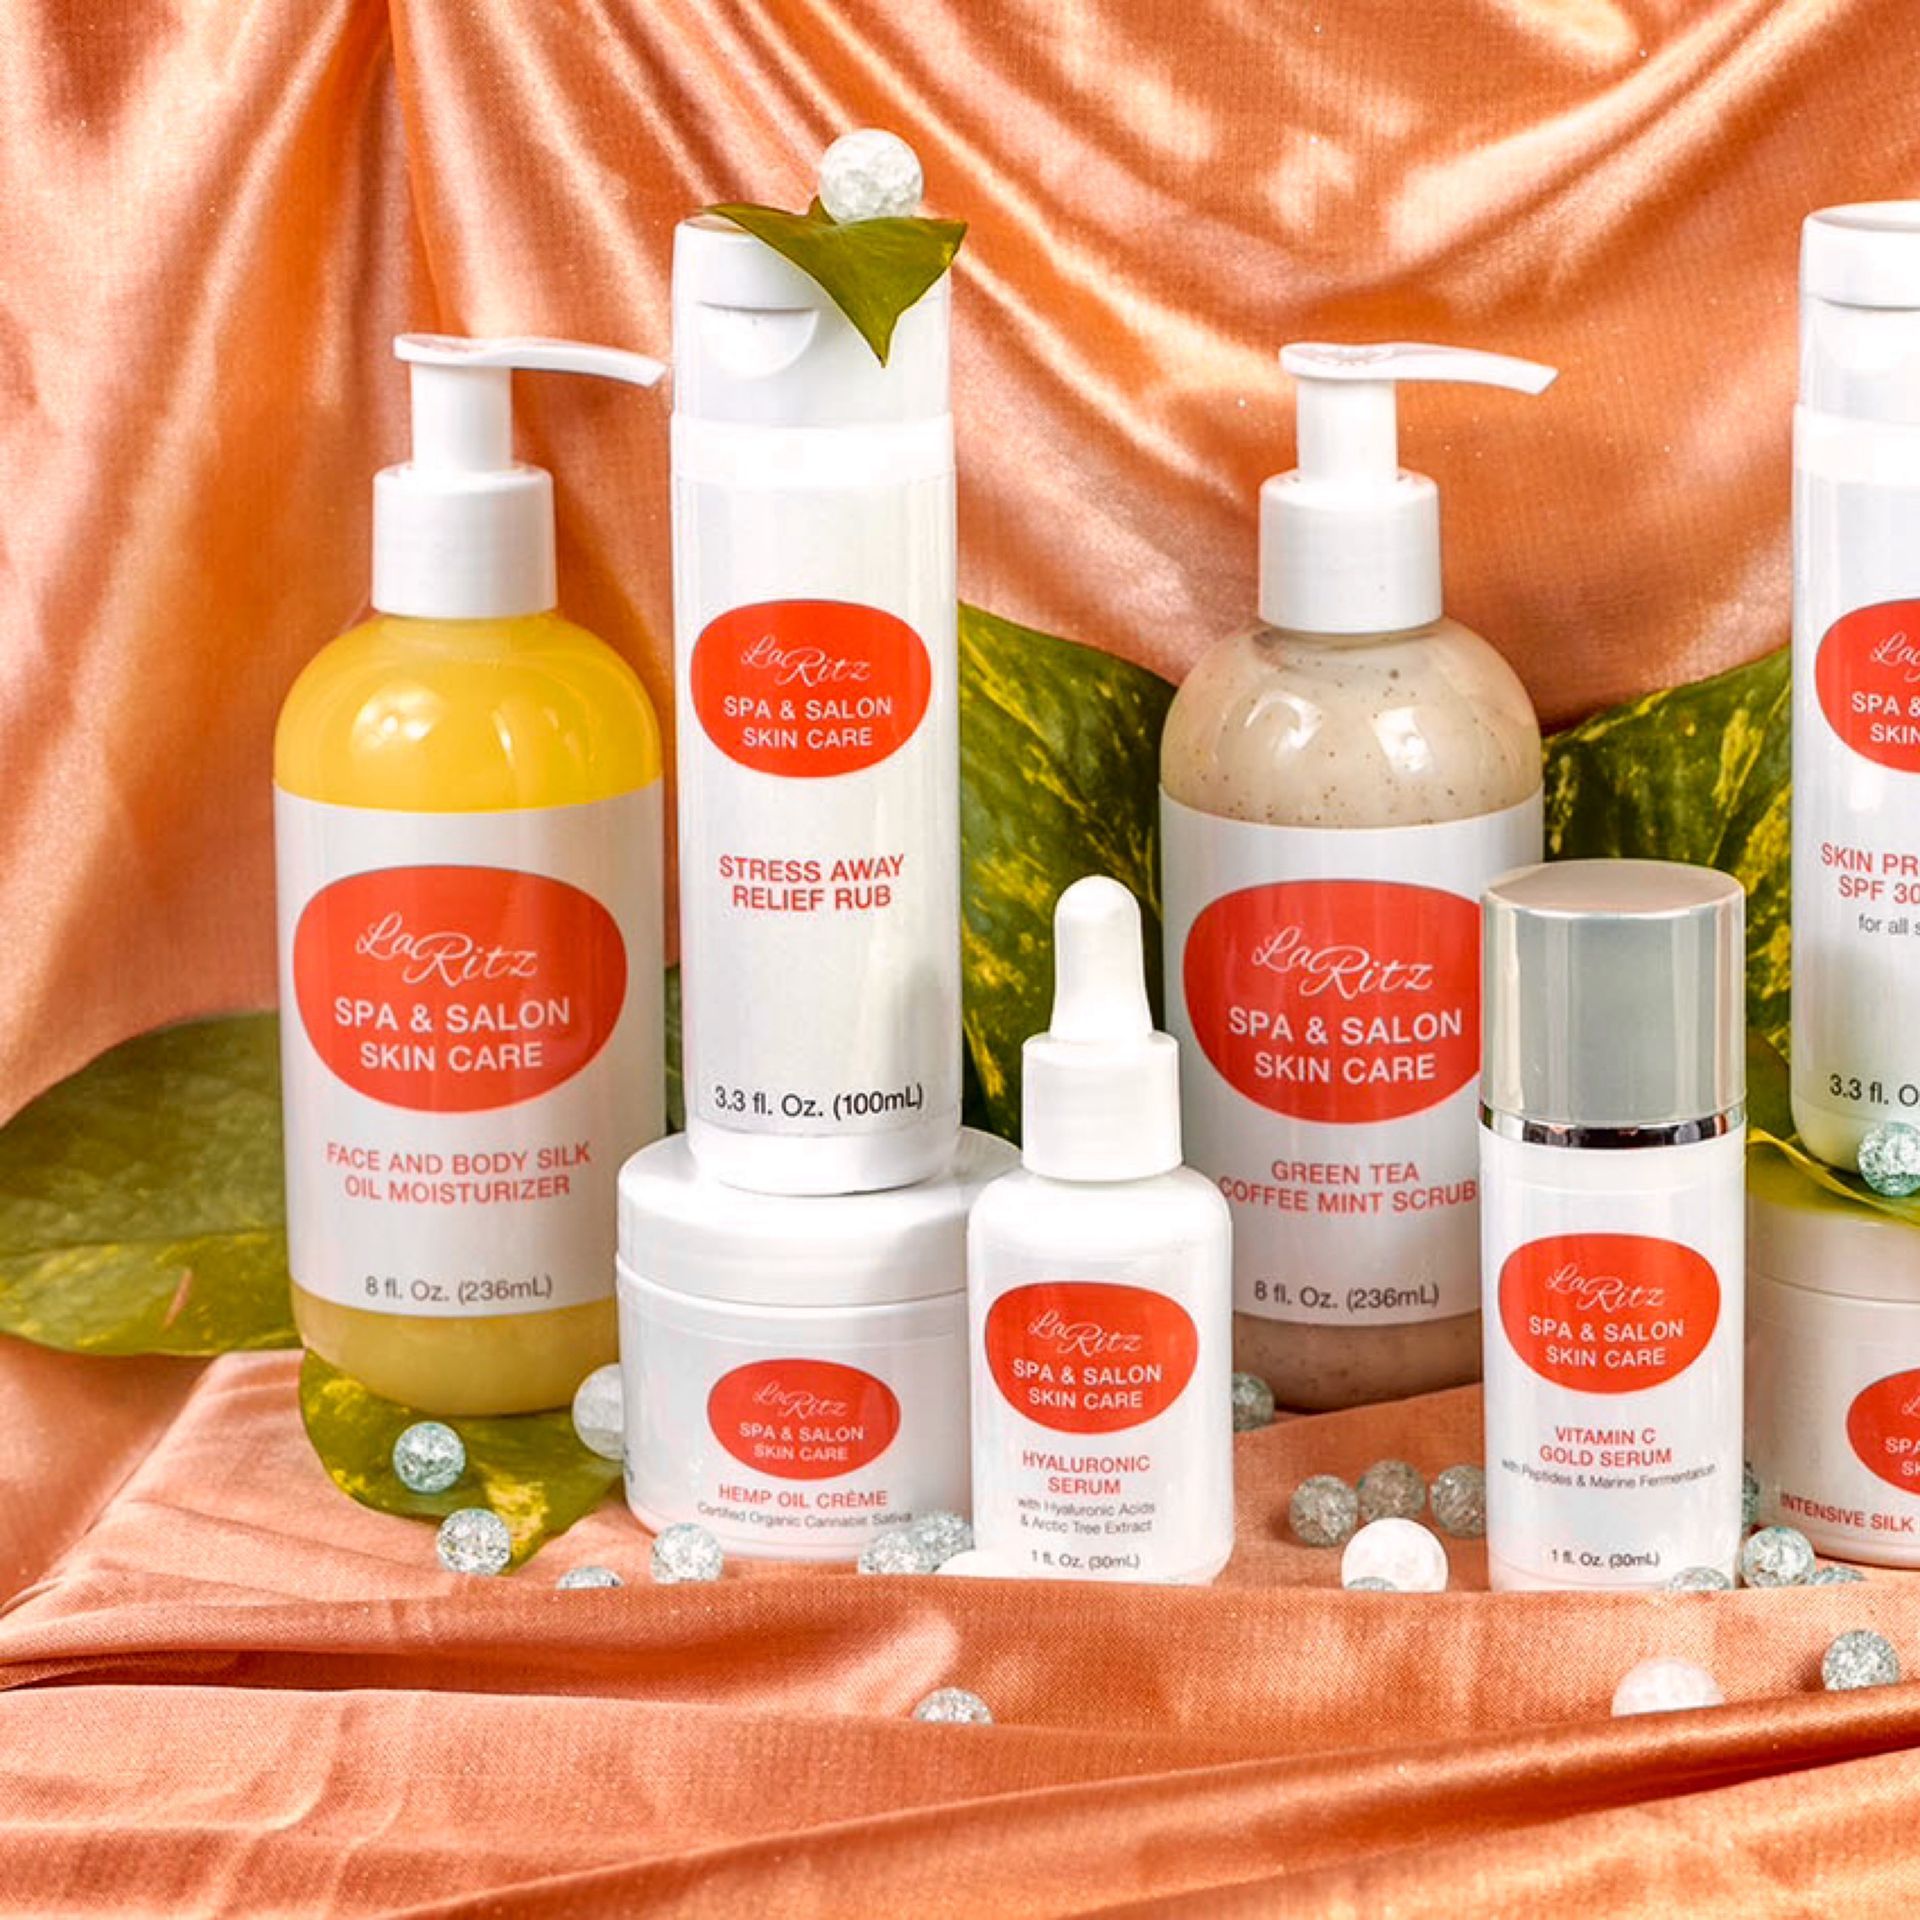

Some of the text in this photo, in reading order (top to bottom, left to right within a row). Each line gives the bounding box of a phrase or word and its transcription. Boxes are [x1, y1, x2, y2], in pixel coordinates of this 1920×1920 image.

[724, 695, 892, 721] SPA & SALON
[1851, 691, 1901, 716] SPA
[743, 727, 873, 750] SKIN CARE
[719, 853, 904, 882] STRESS AWAY
[1821, 842, 1873, 873] SKIN
[732, 886, 891, 911] RELIEF RUB
[1839, 874, 1885, 901] SPF
[1858, 913, 1882, 933] for
[1887, 917, 1909, 935] all
[335, 997, 570, 1034] SPA & SALON
[1229, 1007, 1461, 1046] SPA & SALON
[360, 1042, 543, 1073] SKIN CARE
[1254, 1052, 1436, 1084] SKIN CARE
[715, 1083, 924, 1120] 3.3 fl. Oz. (100mL)
[1829, 1073, 1862, 1101] 3.3
[1870, 1081, 1889, 1105] fl.
[326, 1142, 591, 1176] FACE AND BODY SILK
[1272, 1160, 1420, 1185] GREEN TEA
[345, 1175, 570, 1204] OIL MOISTURIZER
[1219, 1176, 1477, 1214] COFFEE MINT SCRUB
[365, 1275, 552, 1305] 8 fl. Oz. (236mL)
[1255, 1280, 1440, 1312] 8 fl. Oz. (236mL)
[1529, 1315, 1684, 1342] SPA & SALON
[1546, 1346, 1666, 1368] SKIN CARE
[1012, 1358, 1163, 1386] SPA & SALON
[1028, 1387, 1143, 1410] SKIN CARE
[739, 1422, 864, 1442] SPA & SALON
[1554, 1426, 1656, 1445] VITAMIN C
[754, 1442, 849, 1462] SKIN CARE
[1022, 1450, 1151, 1473] HYALURONIC
[1539, 1445, 1672, 1467] GOLD SERUM
[1047, 1477, 1121, 1495] SERUM
[1522, 1464, 1572, 1486] Peptides
[1576, 1475, 1586, 1488] &
[1590, 1476, 1636, 1489] Marine
[718, 1484, 772, 1504] HEMP
[777, 1491, 810, 1508] OIL
[1044, 1501, 1114, 1516] Hyaluronic
[1119, 1503, 1155, 1515] Acids
[750, 1511, 800, 1527] Organic
[1780, 1493, 1914, 1533] INTENSIVE SILK
[1032, 1517, 1068, 1533] Arctic
[1073, 1522, 1101, 1535] Tree
[1105, 1520, 1153, 1535] Extract
[1059, 1554, 1084, 1568] Oz.
[1089, 1555, 1140, 1570] (30mL)
[1580, 1553, 1604, 1568] Oz.
[1609, 1552, 1661, 1569] (30mL)
